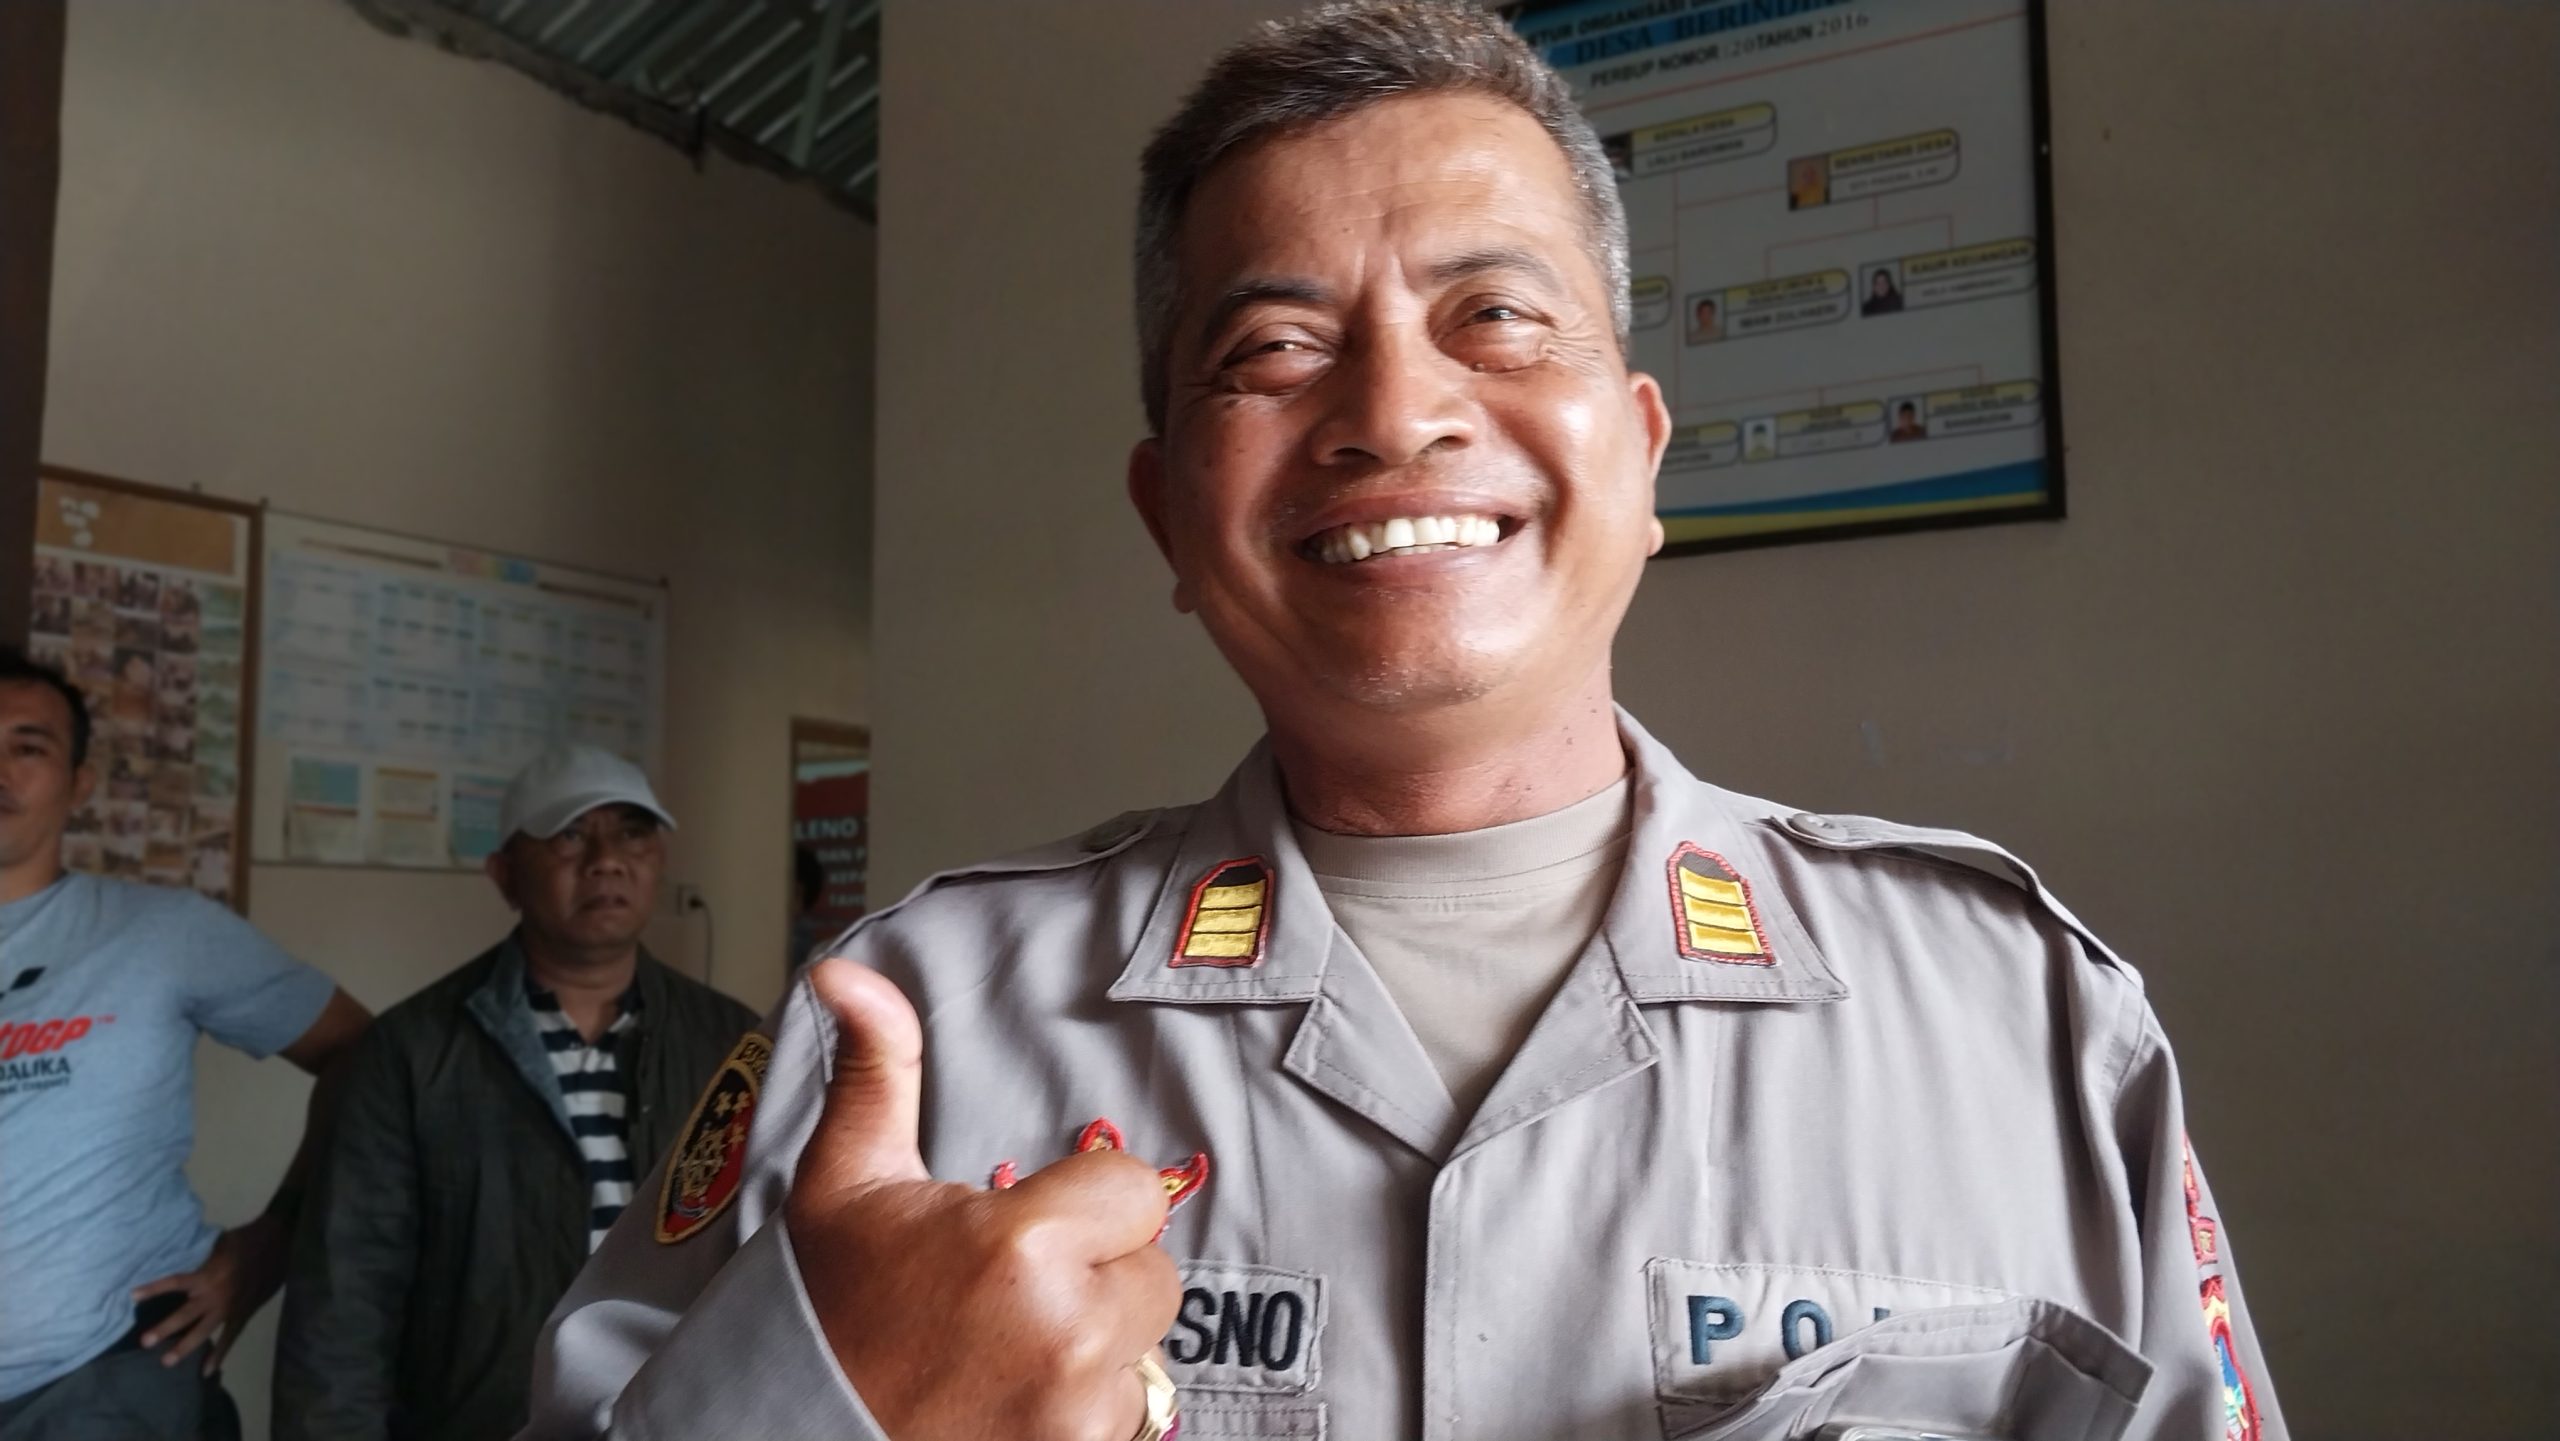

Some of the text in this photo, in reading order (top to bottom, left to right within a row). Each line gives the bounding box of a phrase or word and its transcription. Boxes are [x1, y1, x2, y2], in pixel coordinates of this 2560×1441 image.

[1574, 25, 1654, 65] DESA
[1589, 57, 1655, 89] PERBUP
[1658, 44, 1719, 72] NOMOR
[1817, 11, 1871, 37] 2016
[1160, 1285, 1304, 1372] SNO
[1687, 1294, 1891, 1366] PO
